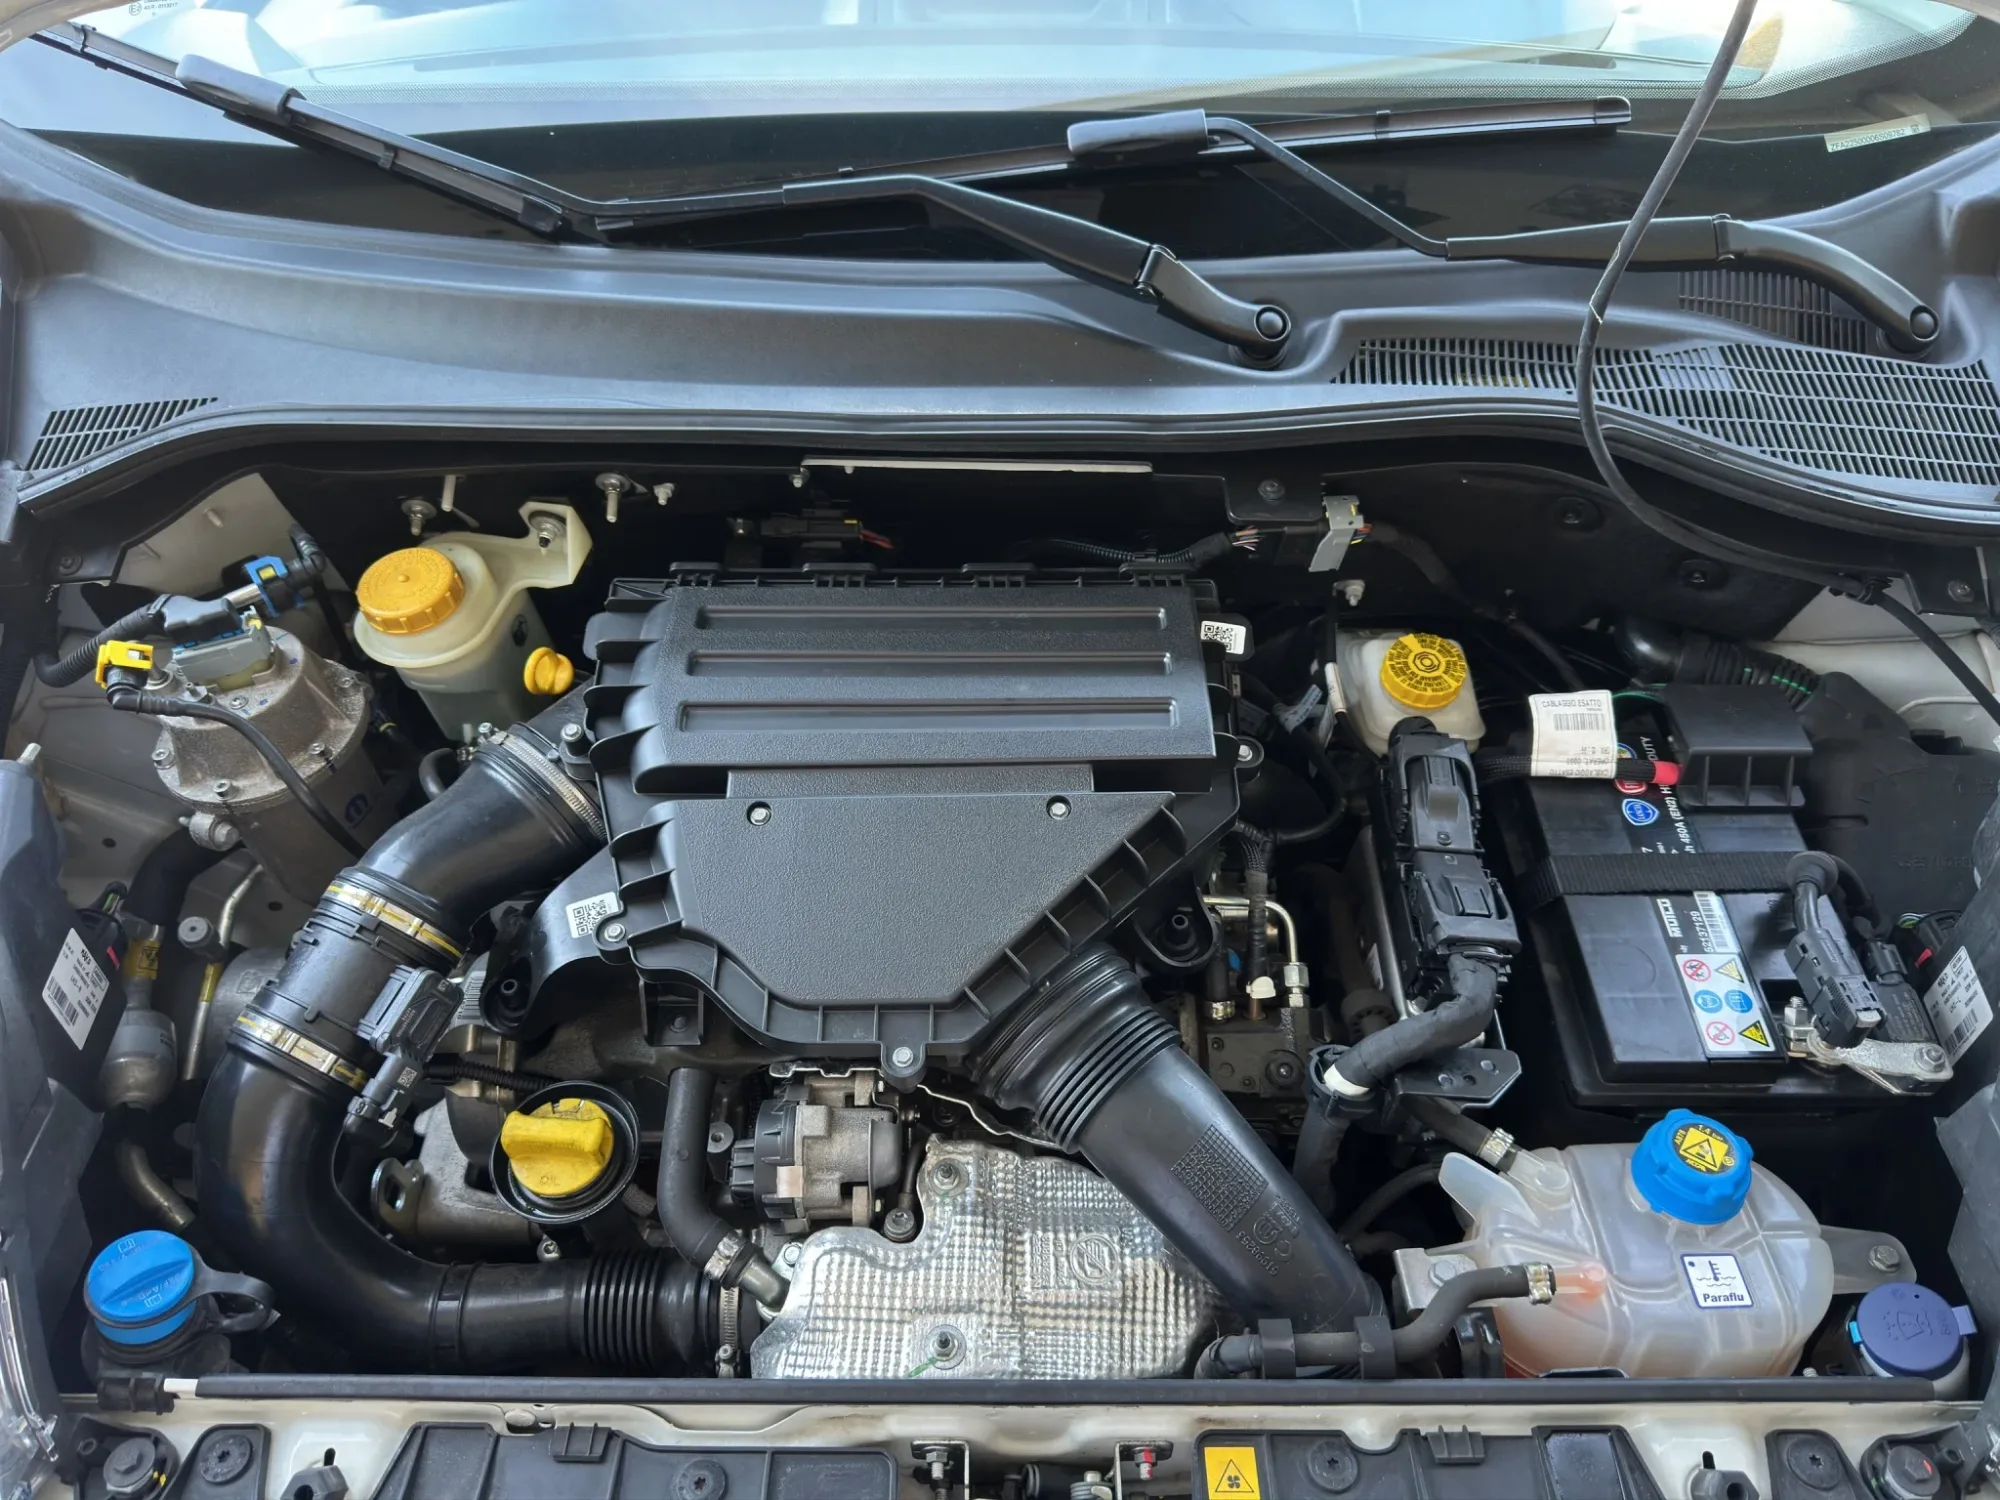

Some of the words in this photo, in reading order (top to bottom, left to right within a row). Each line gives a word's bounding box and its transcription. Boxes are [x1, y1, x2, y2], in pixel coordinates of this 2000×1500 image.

[1578, 699, 1602, 707] ESATTO
[1664, 797, 1685, 820] (EN2)
[1674, 822, 1691, 844] 450A
[1689, 910, 1715, 953] 52137129
[1698, 1124, 1711, 1135] 1.4
[1702, 1292, 1745, 1303] Paraflu
